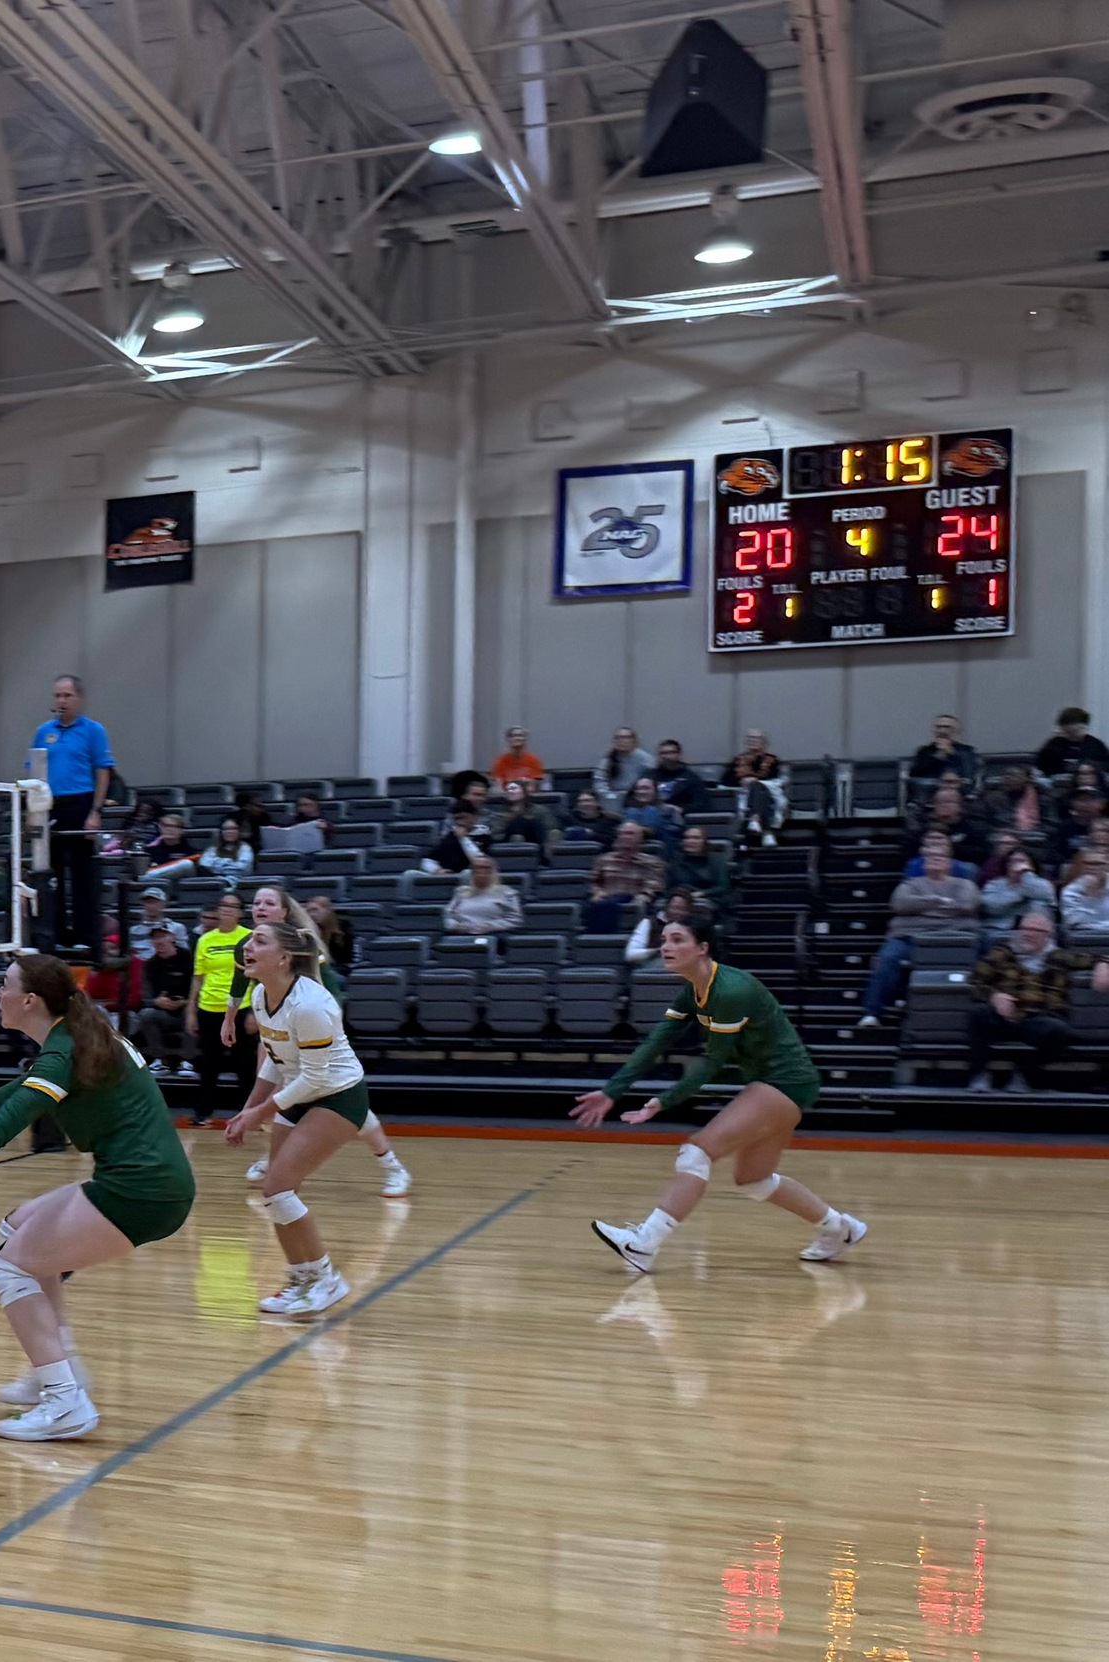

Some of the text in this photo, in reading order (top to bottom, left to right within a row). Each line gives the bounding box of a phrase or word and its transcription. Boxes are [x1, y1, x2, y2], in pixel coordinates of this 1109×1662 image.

[841, 439, 927, 484] 1:15
[925, 485, 1001, 509] GUEST
[728, 502, 791, 524] HOME
[832, 506, 887, 522] PERIOD
[580, 504, 666, 559] 25
[846, 528, 871, 556] 4
[937, 515, 998, 556] 24
[735, 528, 792, 570] 20
[810, 568, 868, 584] PLAYER
[956, 559, 1007, 575] FOULS
[716, 576, 764, 591] FOULS
[988, 578, 997, 606] 1
[733, 592, 755, 624] 2
[785, 598, 794, 618] 1
[931, 588, 941, 609] 1
[831, 623, 887, 639] MATCH
[954, 616, 1007, 632] SCORE
[716, 630, 764, 646] SCORE
